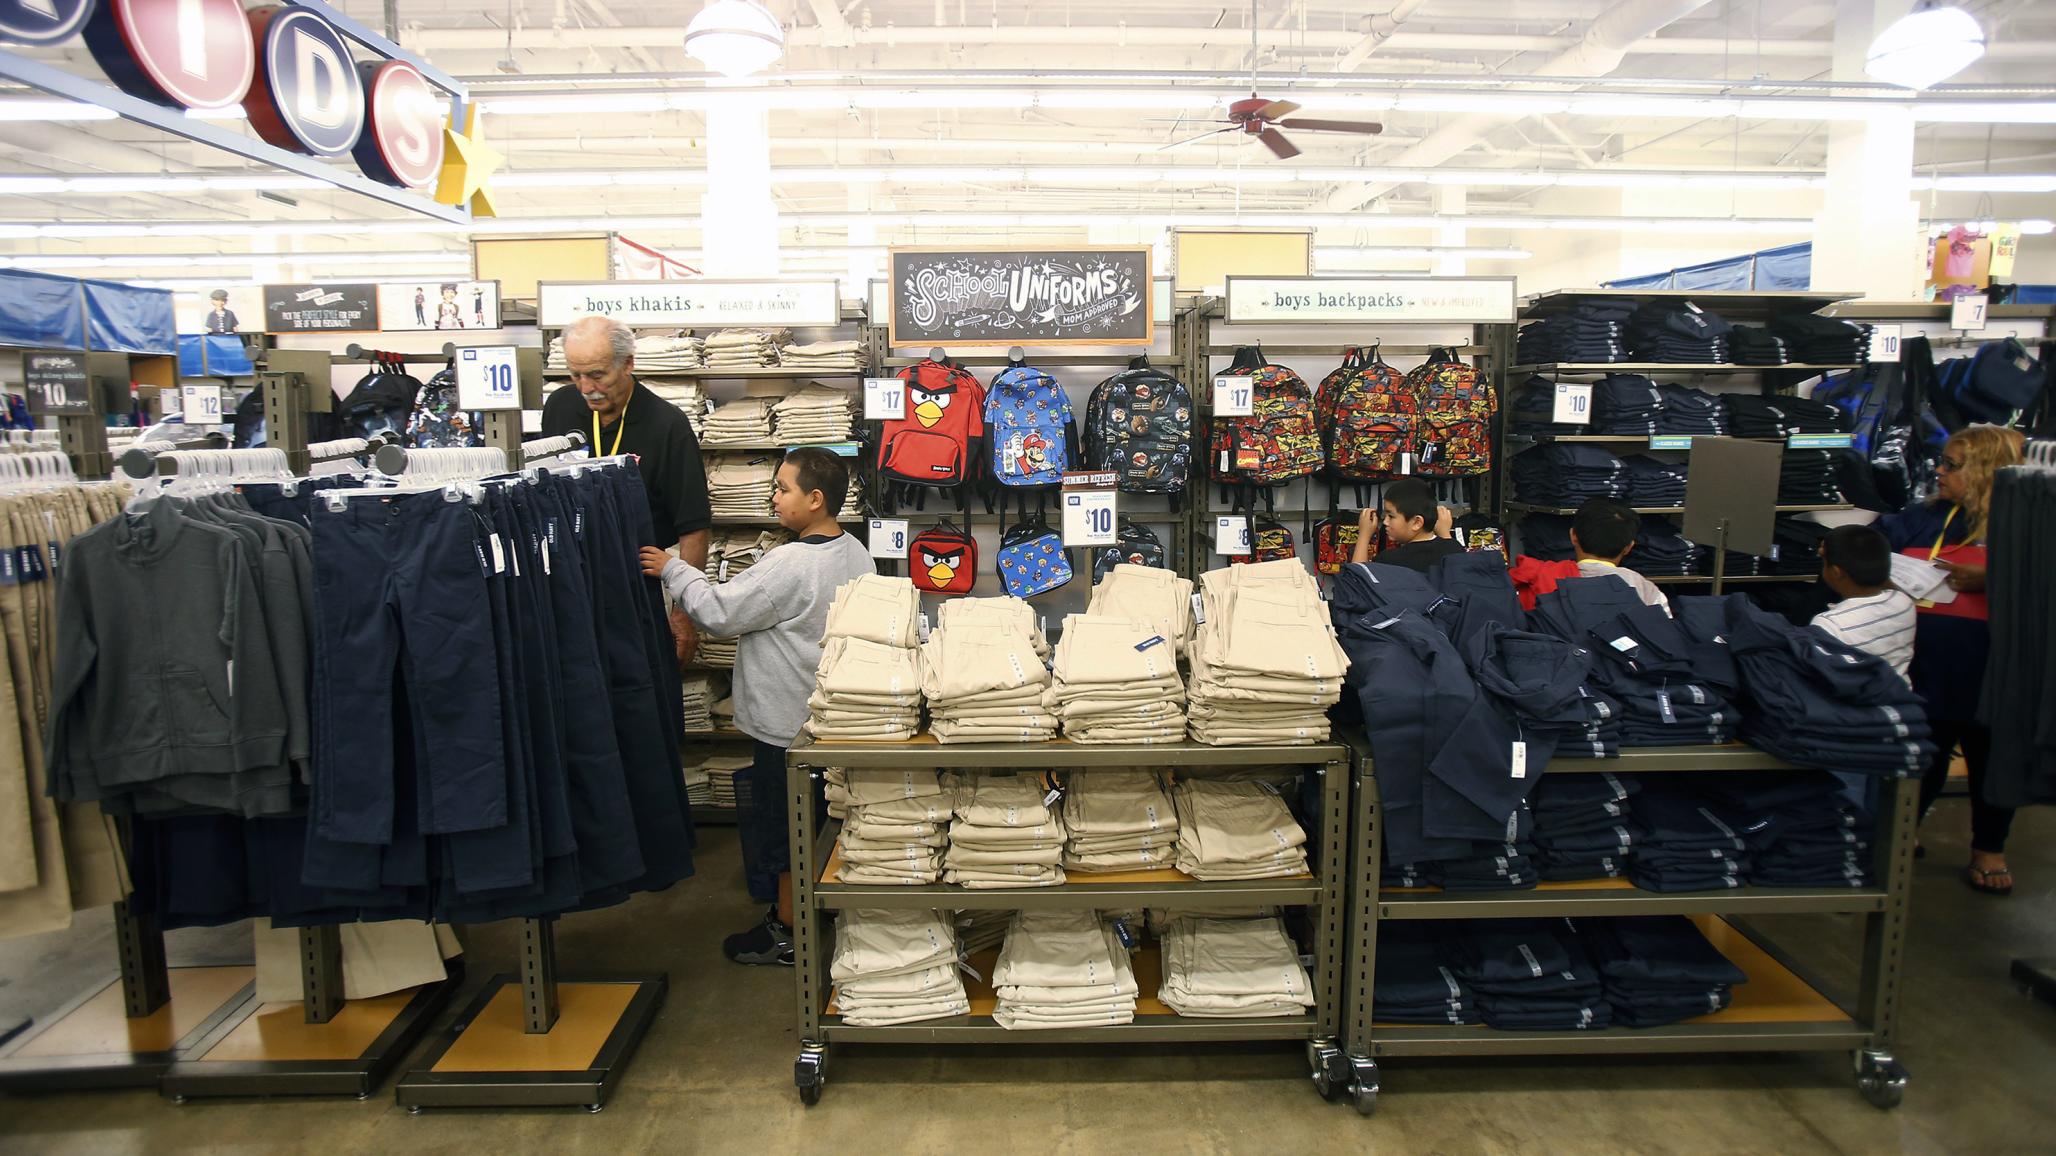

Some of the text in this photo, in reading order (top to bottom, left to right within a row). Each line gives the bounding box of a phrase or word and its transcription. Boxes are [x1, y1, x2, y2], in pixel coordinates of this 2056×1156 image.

[586, 296, 691, 316] boys khakis
[768, 300, 797, 311] SKINNY
[1274, 292, 1403, 310] boys backpacks
[1063, 299, 1118, 324] MOM APPROVED
[484, 364, 512, 391] $10
[882, 391, 900, 409] $17
[1230, 389, 1249, 407] $17
[1569, 395, 1586, 412] $10
[1063, 475, 1089, 485] SUMMER
[1090, 473, 1116, 483] REFRESH
[1085, 508, 1111, 533] $10
[892, 531, 904, 549] $8
